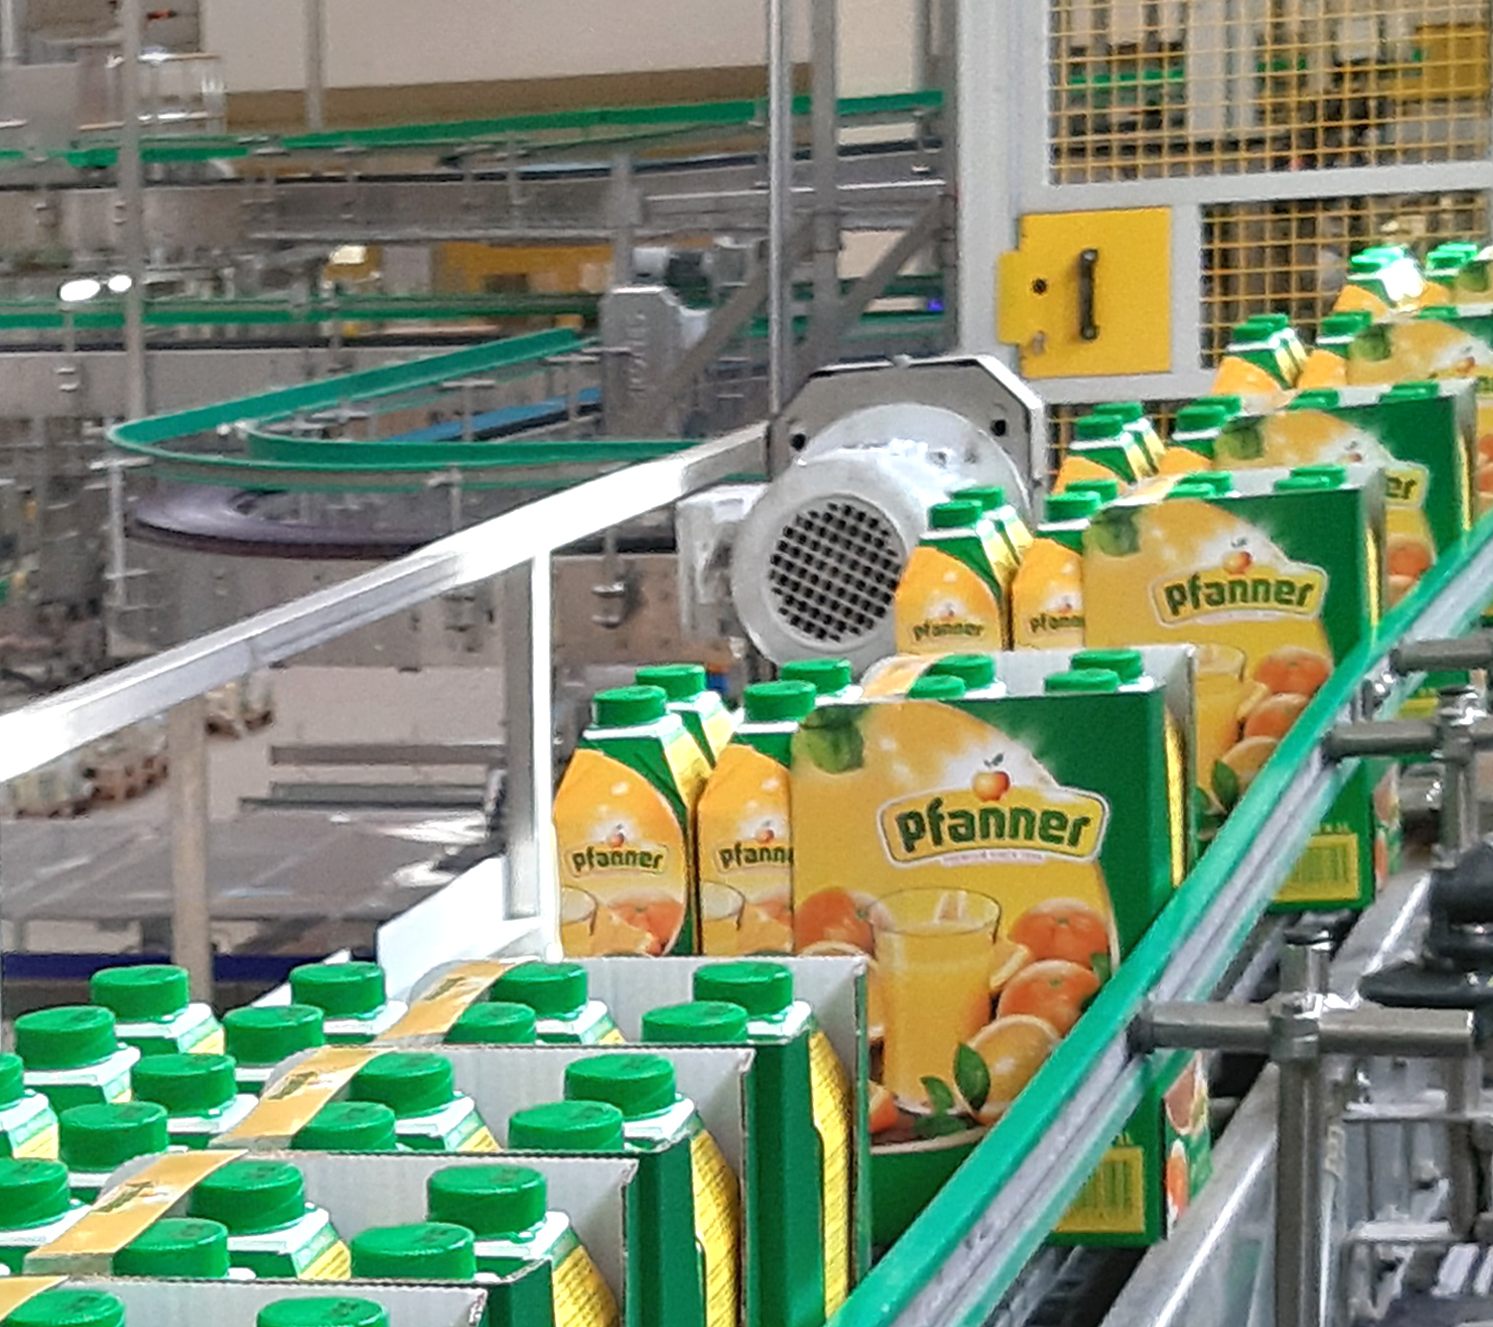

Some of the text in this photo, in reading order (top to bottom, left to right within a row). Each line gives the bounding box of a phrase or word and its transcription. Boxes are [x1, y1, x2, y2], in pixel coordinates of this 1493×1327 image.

[1165, 573, 1315, 617] pfanner
[895, 797, 1092, 853] pfanner
[572, 845, 663, 872] pfanner
